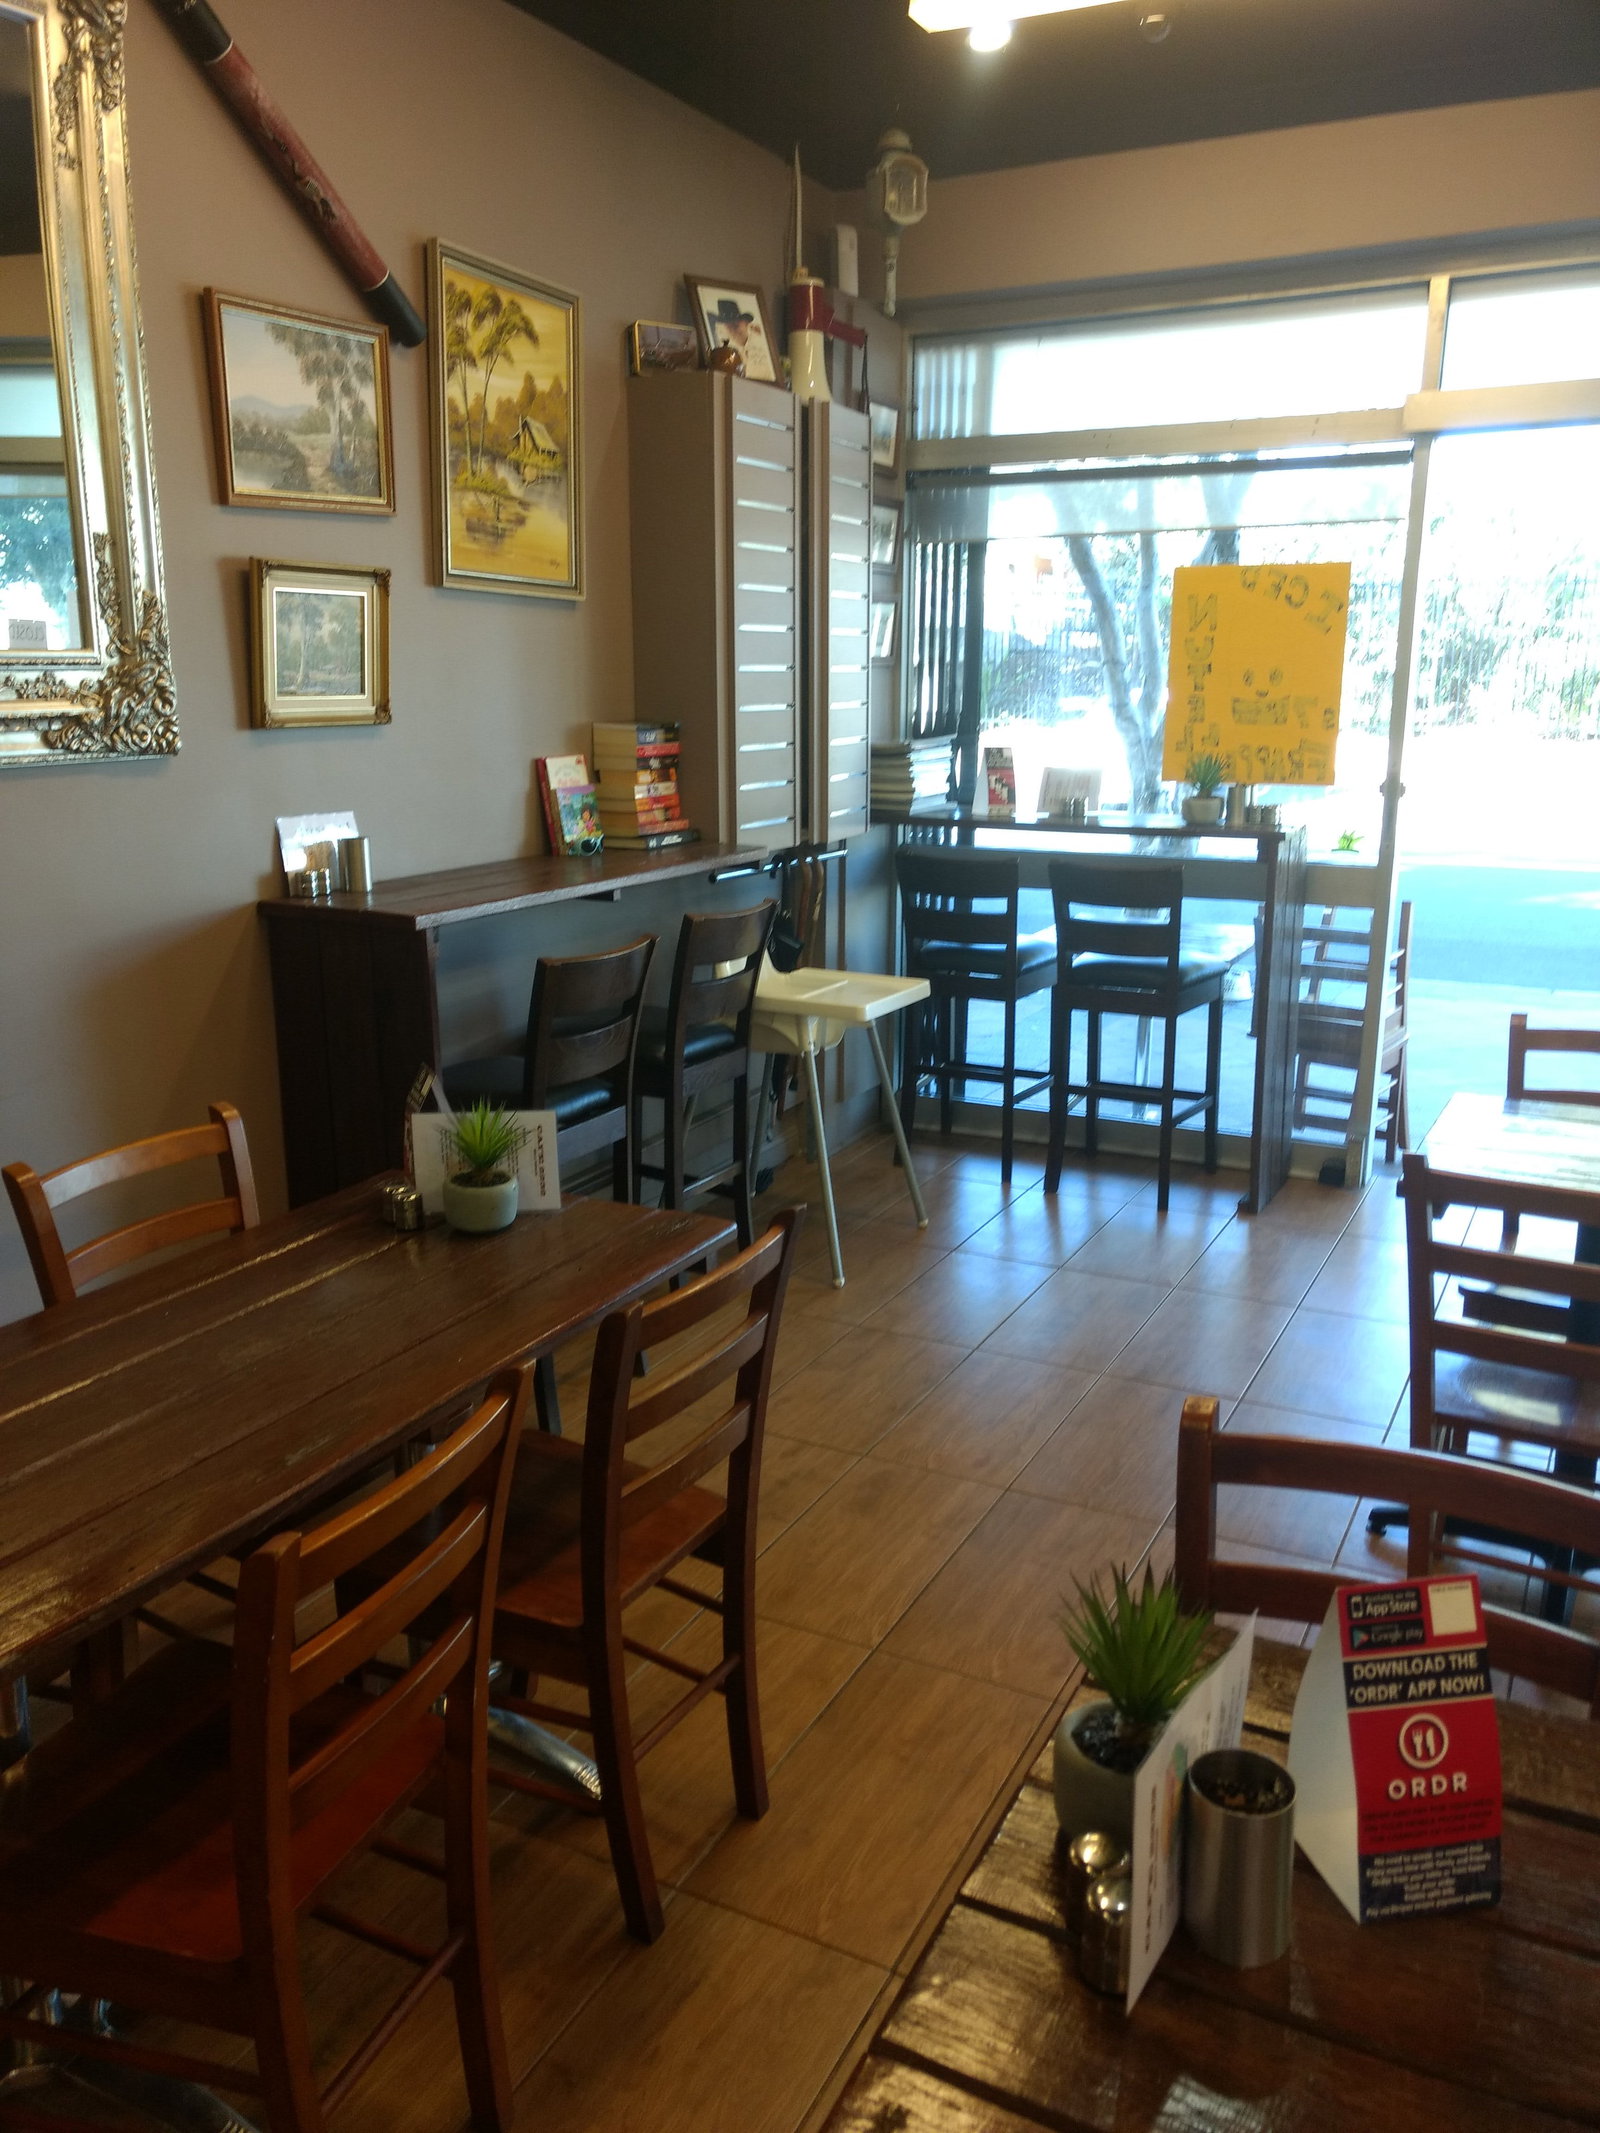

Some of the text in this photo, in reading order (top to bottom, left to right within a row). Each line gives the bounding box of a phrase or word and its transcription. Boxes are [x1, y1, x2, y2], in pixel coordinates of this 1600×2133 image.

[1365, 1599, 1418, 1617] App Store
[1352, 1652, 1478, 1681] DOWNLOAD THE
[1407, 1680, 1438, 1699] APP
[1440, 1674, 1485, 1695] NOW!
[1388, 1772, 1468, 1801] ORDR
